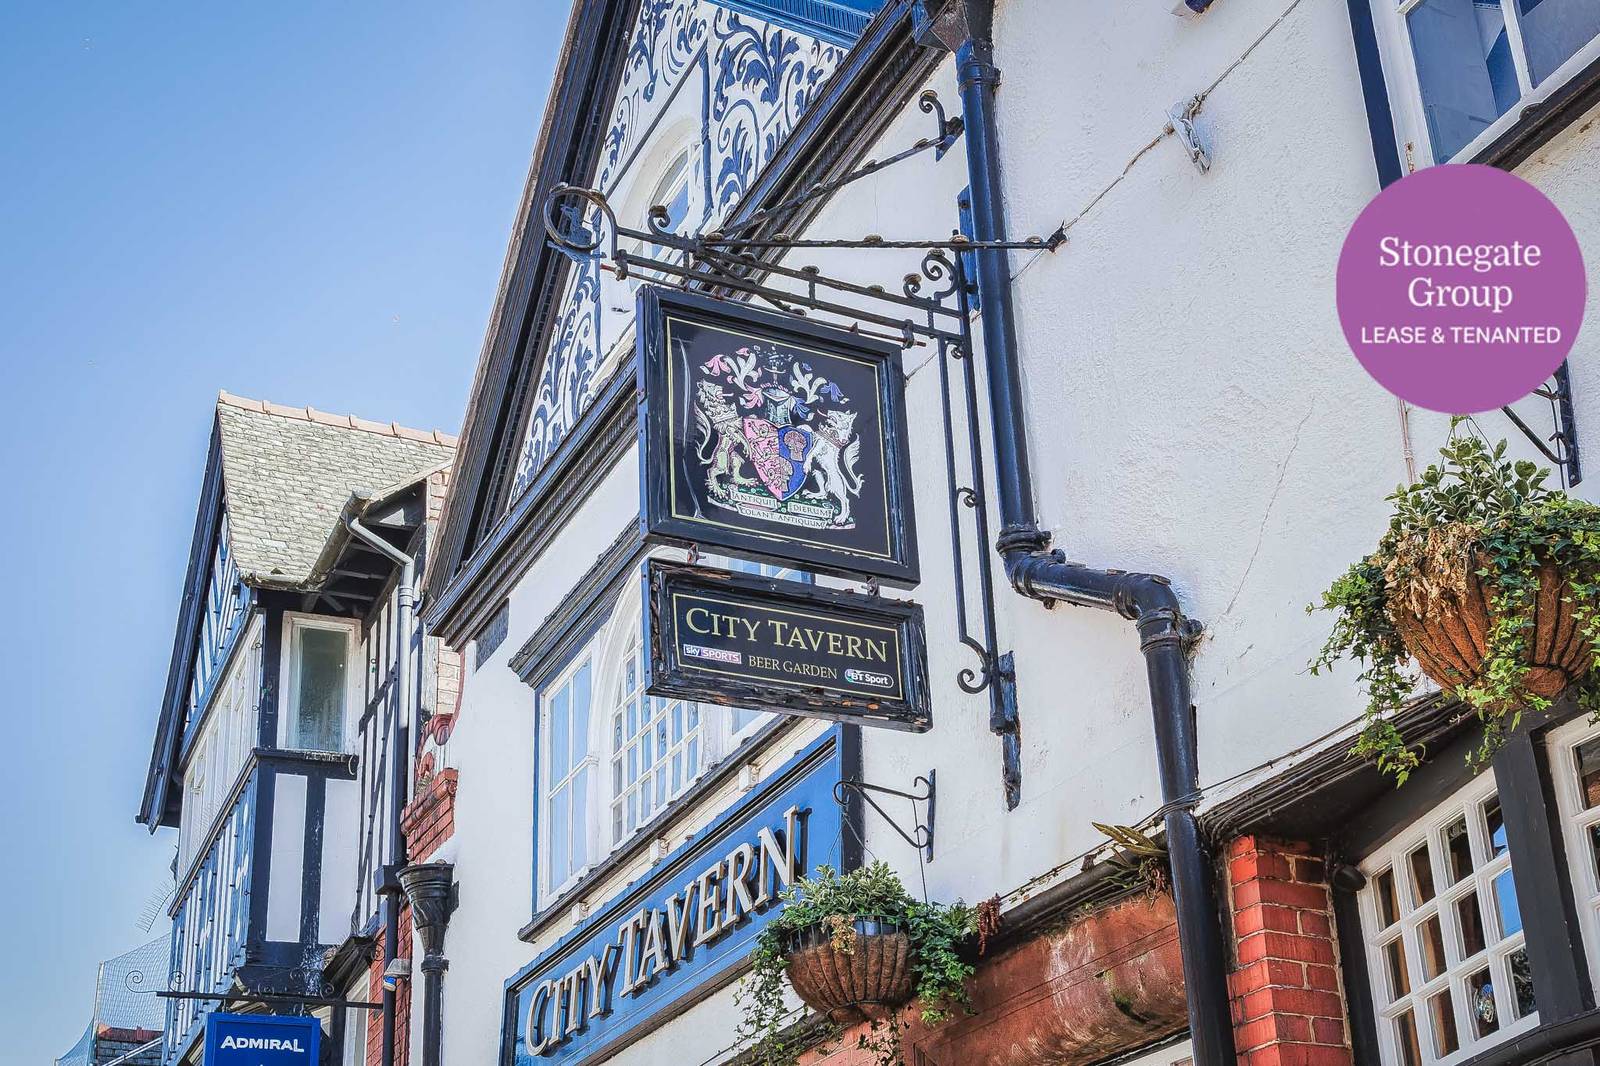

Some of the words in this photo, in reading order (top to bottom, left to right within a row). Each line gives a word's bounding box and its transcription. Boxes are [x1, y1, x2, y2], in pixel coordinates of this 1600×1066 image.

[740, 507, 774, 519] COLANT
[793, 504, 829, 518] DIERUM
[685, 607, 761, 642] CITY
[768, 619, 888, 663] TAVERN
[686, 645, 700, 656] sky
[702, 649, 740, 662] SPORTS
[748, 655, 780, 671] BEER
[783, 660, 838, 679] GARDEN
[850, 672, 864, 681] BT
[864, 673, 889, 685] Sport
[525, 943, 622, 1057] CITY
[618, 805, 801, 998] TAVERN
[220, 1035, 305, 1053] ADMIRAL
